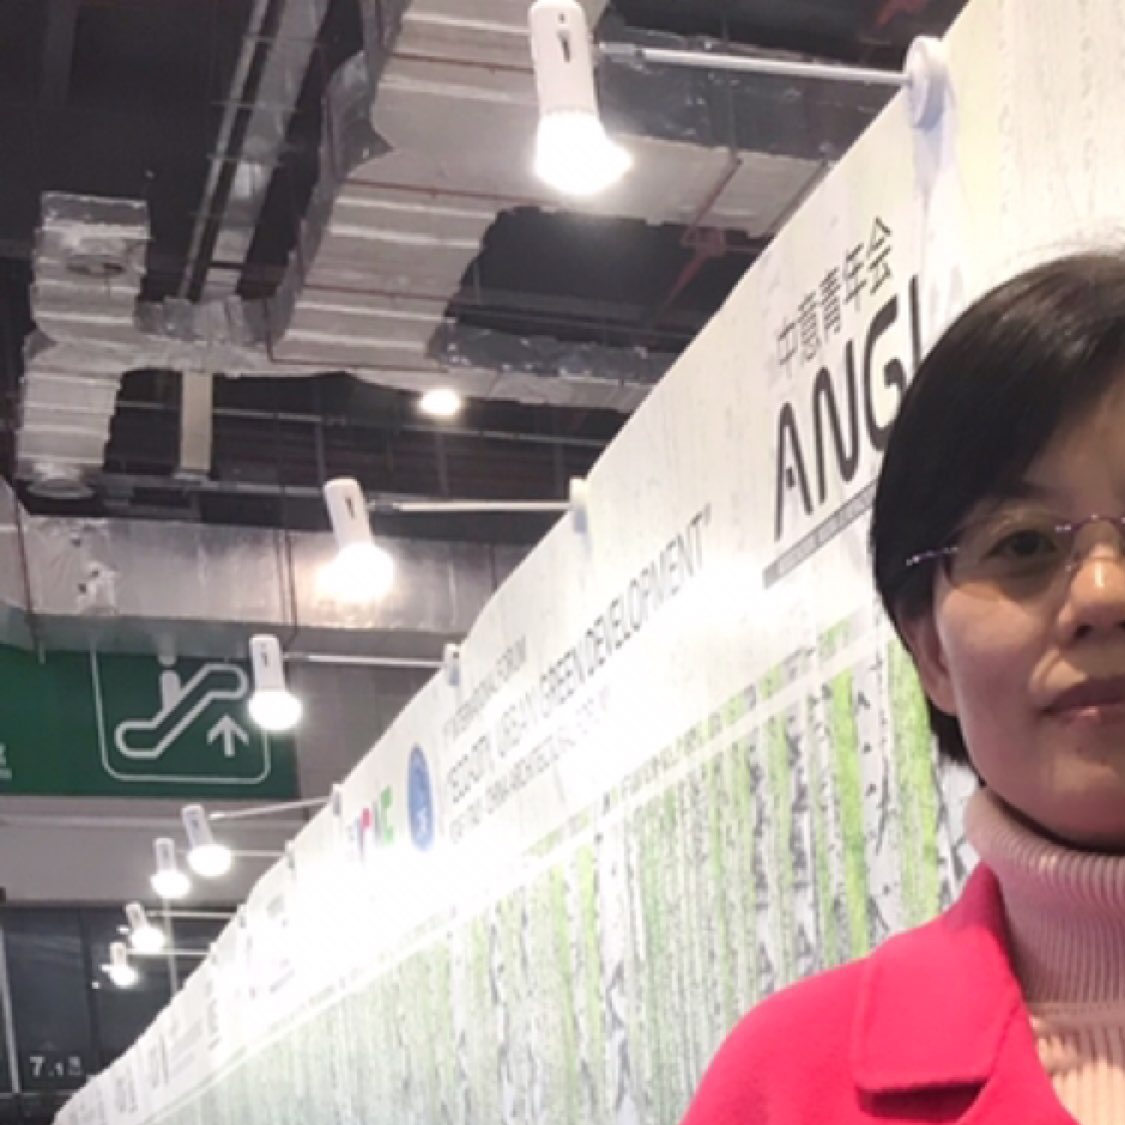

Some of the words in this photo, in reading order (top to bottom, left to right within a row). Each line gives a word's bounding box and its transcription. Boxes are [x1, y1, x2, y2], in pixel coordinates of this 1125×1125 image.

[777, 216, 892, 380] 中意青年会
